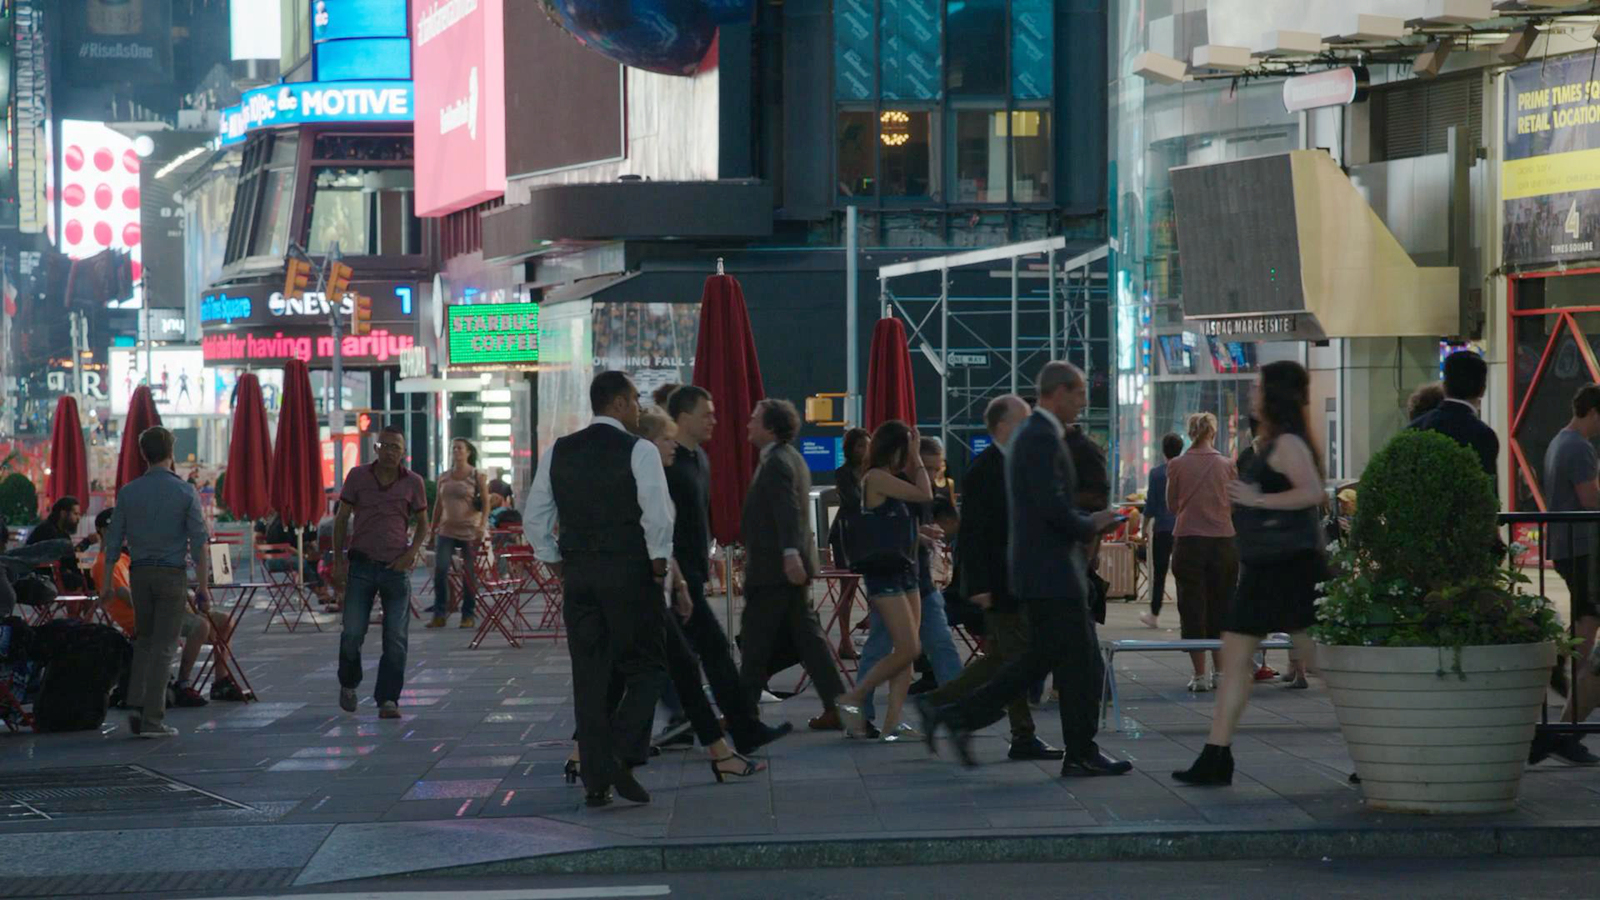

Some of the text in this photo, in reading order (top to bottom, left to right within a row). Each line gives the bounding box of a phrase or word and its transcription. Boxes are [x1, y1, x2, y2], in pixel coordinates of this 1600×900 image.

[302, 89, 408, 117] MOTIVE
[1517, 88, 1550, 111] PRIME
[1551, 82, 1582, 105] TIMES
[1517, 112, 1551, 134] RETAIL
[1551, 241, 1593, 254] TIMES SQUARE
[453, 313, 540, 333] STARBUC
[1200, 317, 1289, 335] NASDAQ MARKETSITE
[247, 331, 312, 362] having
[471, 334, 538, 351] COFFEE
[654, 356, 685, 367] FALL
[949, 355, 983, 364] ONE WAY
